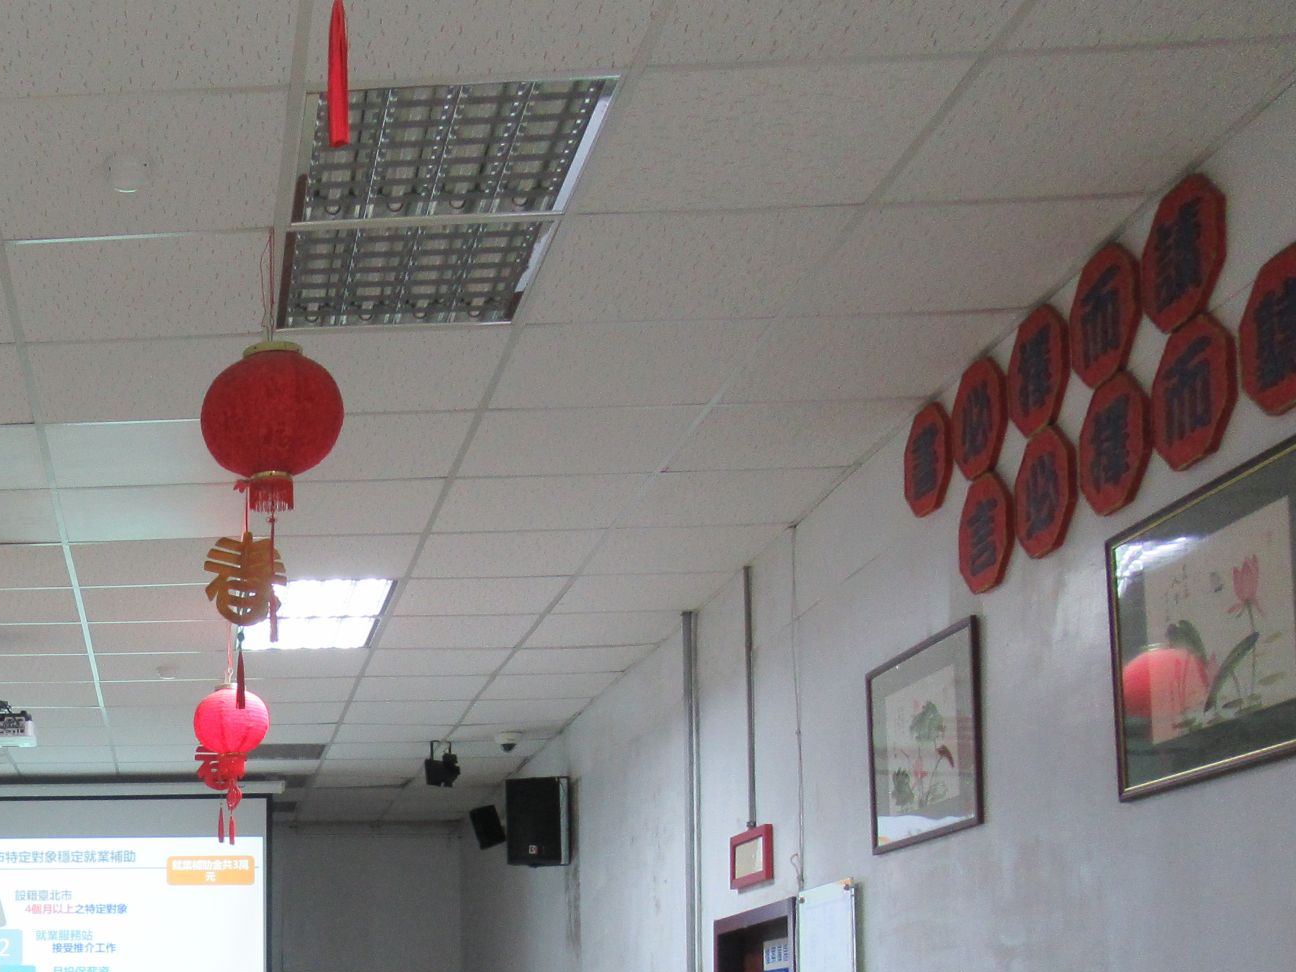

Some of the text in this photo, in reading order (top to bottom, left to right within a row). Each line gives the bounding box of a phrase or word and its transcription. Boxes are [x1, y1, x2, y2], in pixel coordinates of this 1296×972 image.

[15, 889, 72, 902] 設籍臺北市
[24, 903, 128, 915] 4個月以上之特定對象
[35, 929, 93, 941] 就業服務站
[51, 942, 117, 954] 接受推介工作
